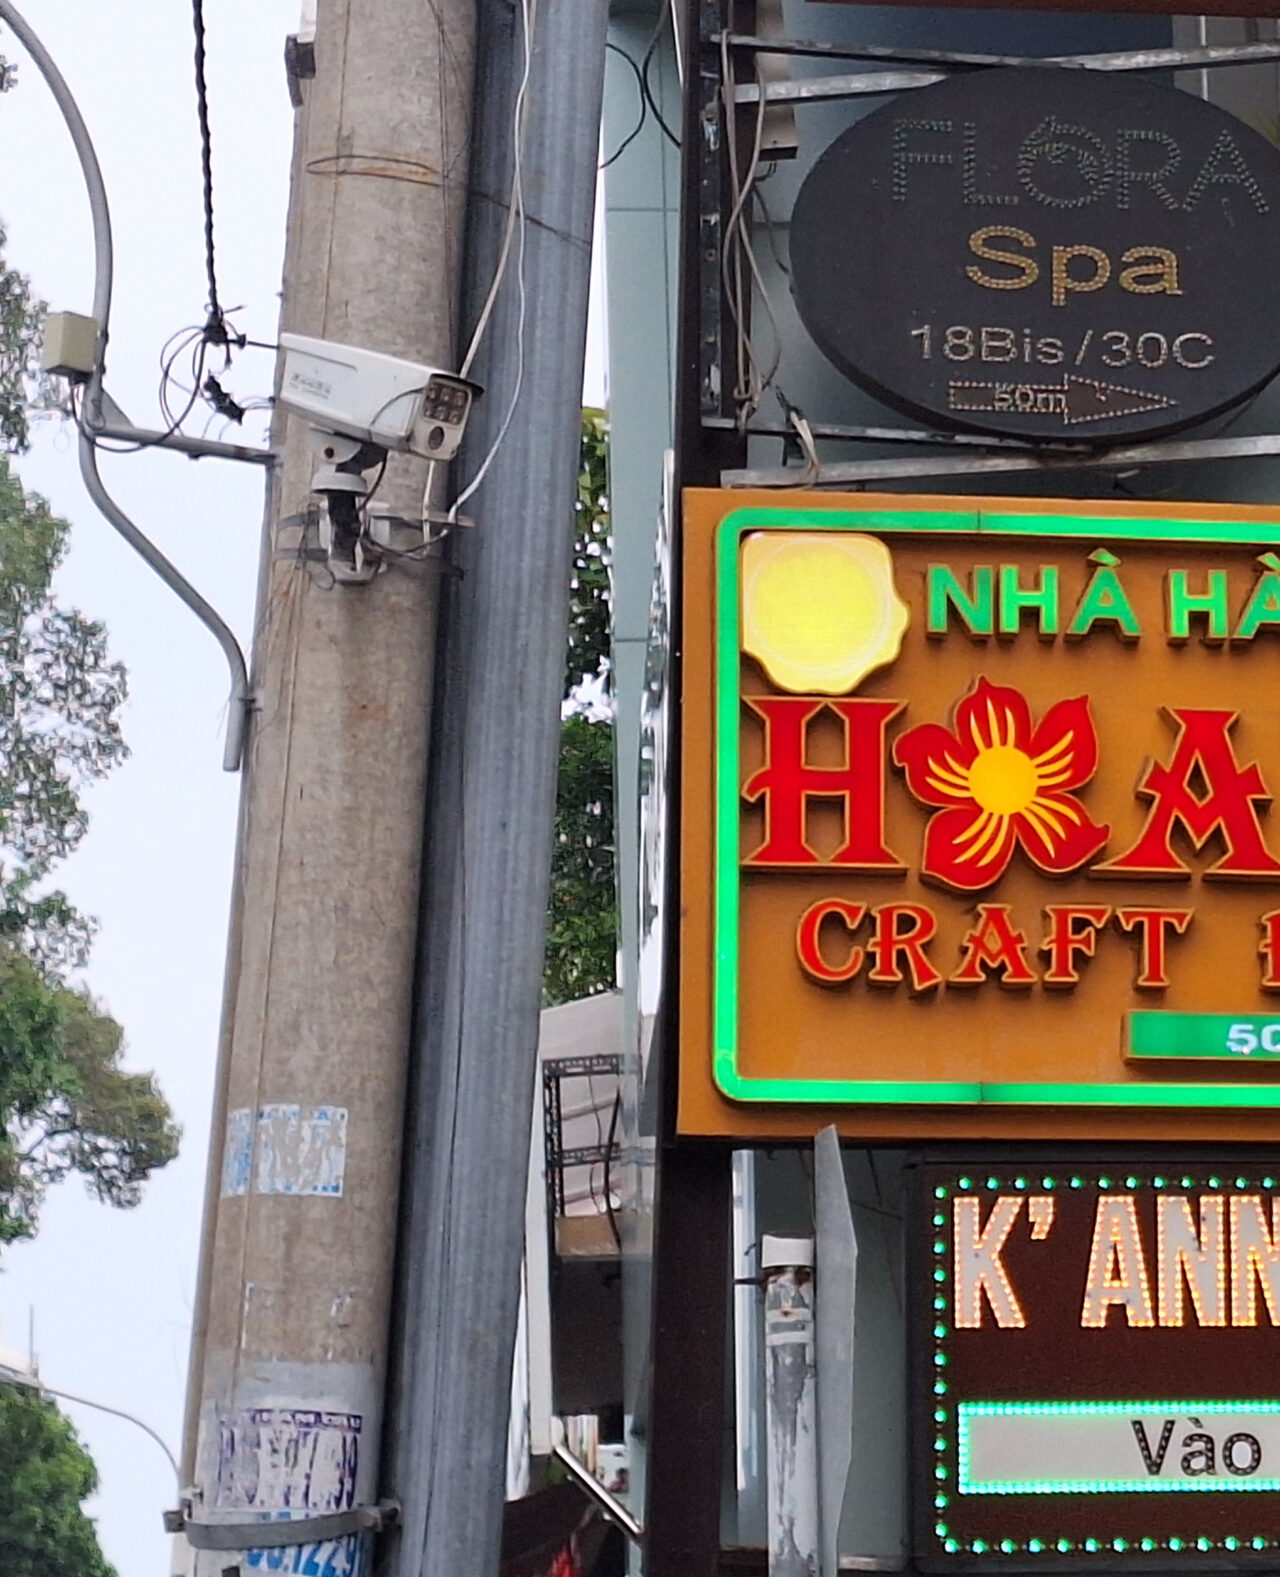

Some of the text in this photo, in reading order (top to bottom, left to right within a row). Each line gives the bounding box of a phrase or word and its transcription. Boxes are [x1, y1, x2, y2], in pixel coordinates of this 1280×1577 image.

[965, 225, 1184, 307] Spa
[911, 323, 1216, 369] 18Bis/30C
[994, 382, 1067, 413] 50m
[926, 547, 1142, 641] NHÀ
[796, 897, 1196, 992] CRAFT
[1130, 1415, 1263, 1477] Vào
